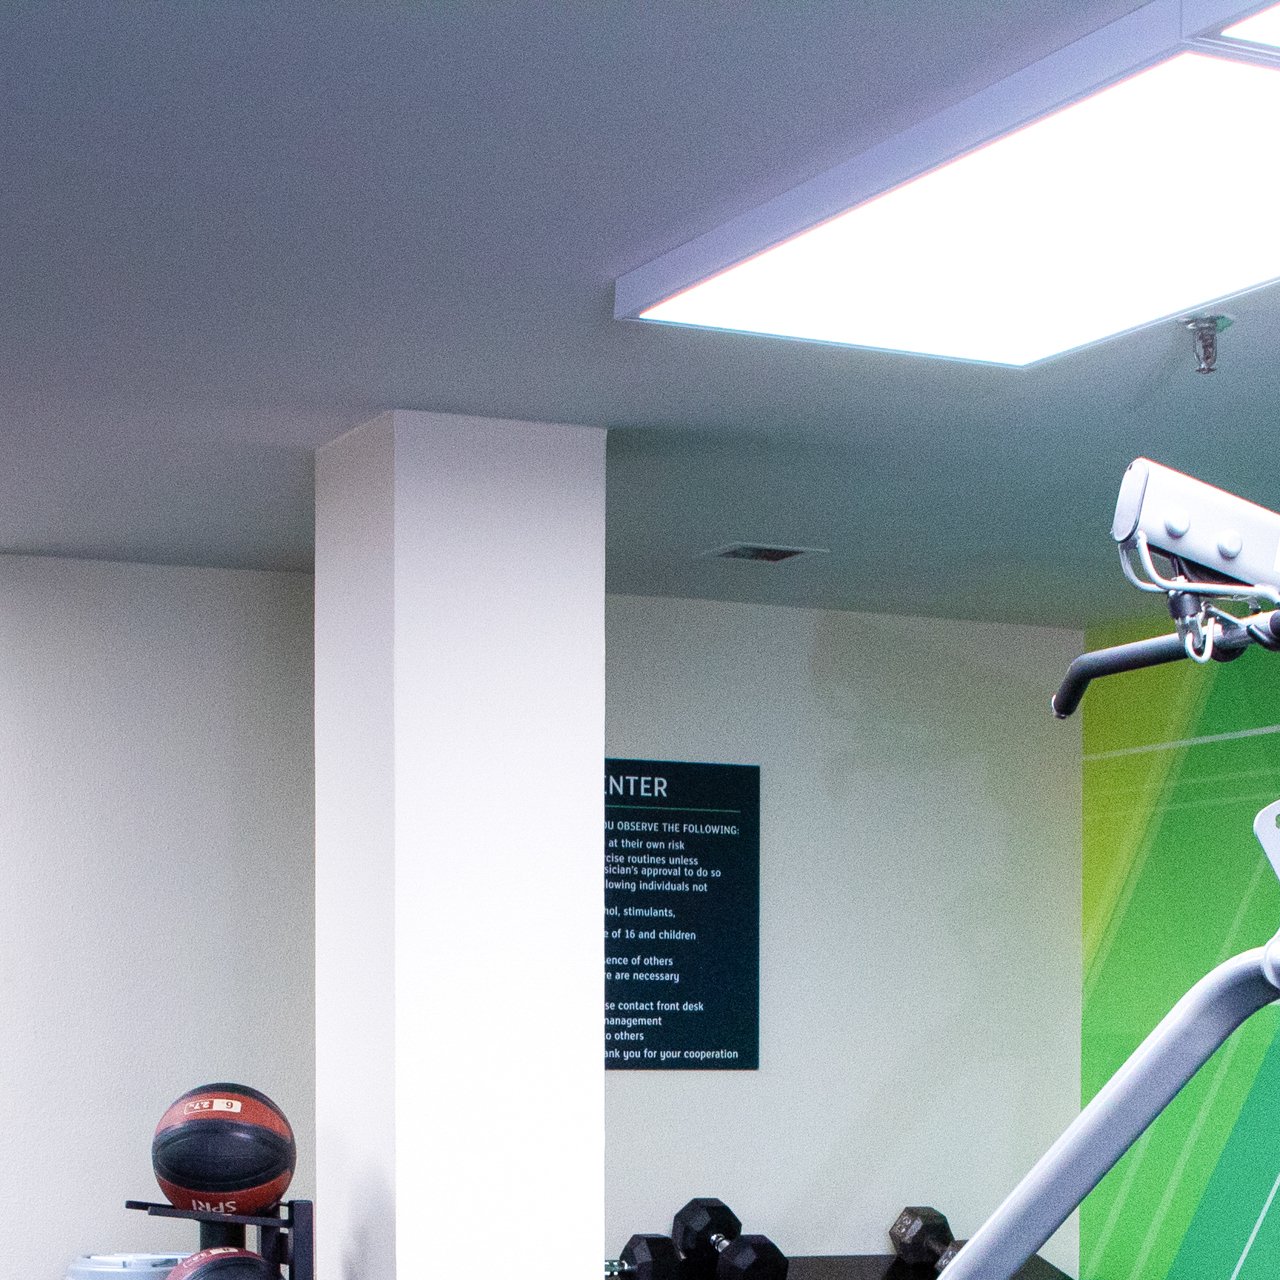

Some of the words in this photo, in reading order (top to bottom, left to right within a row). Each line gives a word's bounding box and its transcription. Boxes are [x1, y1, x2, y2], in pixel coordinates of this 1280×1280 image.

[605, 776, 667, 797] NTER
[617, 821, 658, 831] OBSERVE
[663, 823, 679, 832] THE
[684, 824, 739, 834] FOLLOWING:
[609, 839, 617, 847] at
[622, 839, 642, 848] their
[669, 841, 684, 849] risk
[605, 853, 624, 863] cise
[628, 855, 665, 865] routines
[669, 856, 698, 866] unless
[641, 867, 680, 877] approval
[685, 868, 693, 876] to
[697, 868, 708, 876] do
[640, 881, 689, 891] individuals
[693, 883, 707, 891] not
[624, 907, 675, 917] stimulants,
[612, 929, 621, 938] of
[626, 930, 635, 938] 16
[639, 930, 655, 939] and
[659, 930, 696, 940] children
[631, 955, 641, 965] of
[644, 956, 673, 965] others
[615, 972, 629, 980] are
[633, 973, 679, 983] necessary
[618, 1002, 653, 1010] contact
[657, 1001, 679, 1011] front
[683, 1002, 703, 1011] desk
[614, 1031, 644, 1040] others
[623, 1051, 640, 1060] you
[644, 1048, 657, 1058] for
[660, 1051, 681, 1060] your
[684, 1049, 738, 1060] cooperation
[191, 1199, 237, 1213] SPRI
